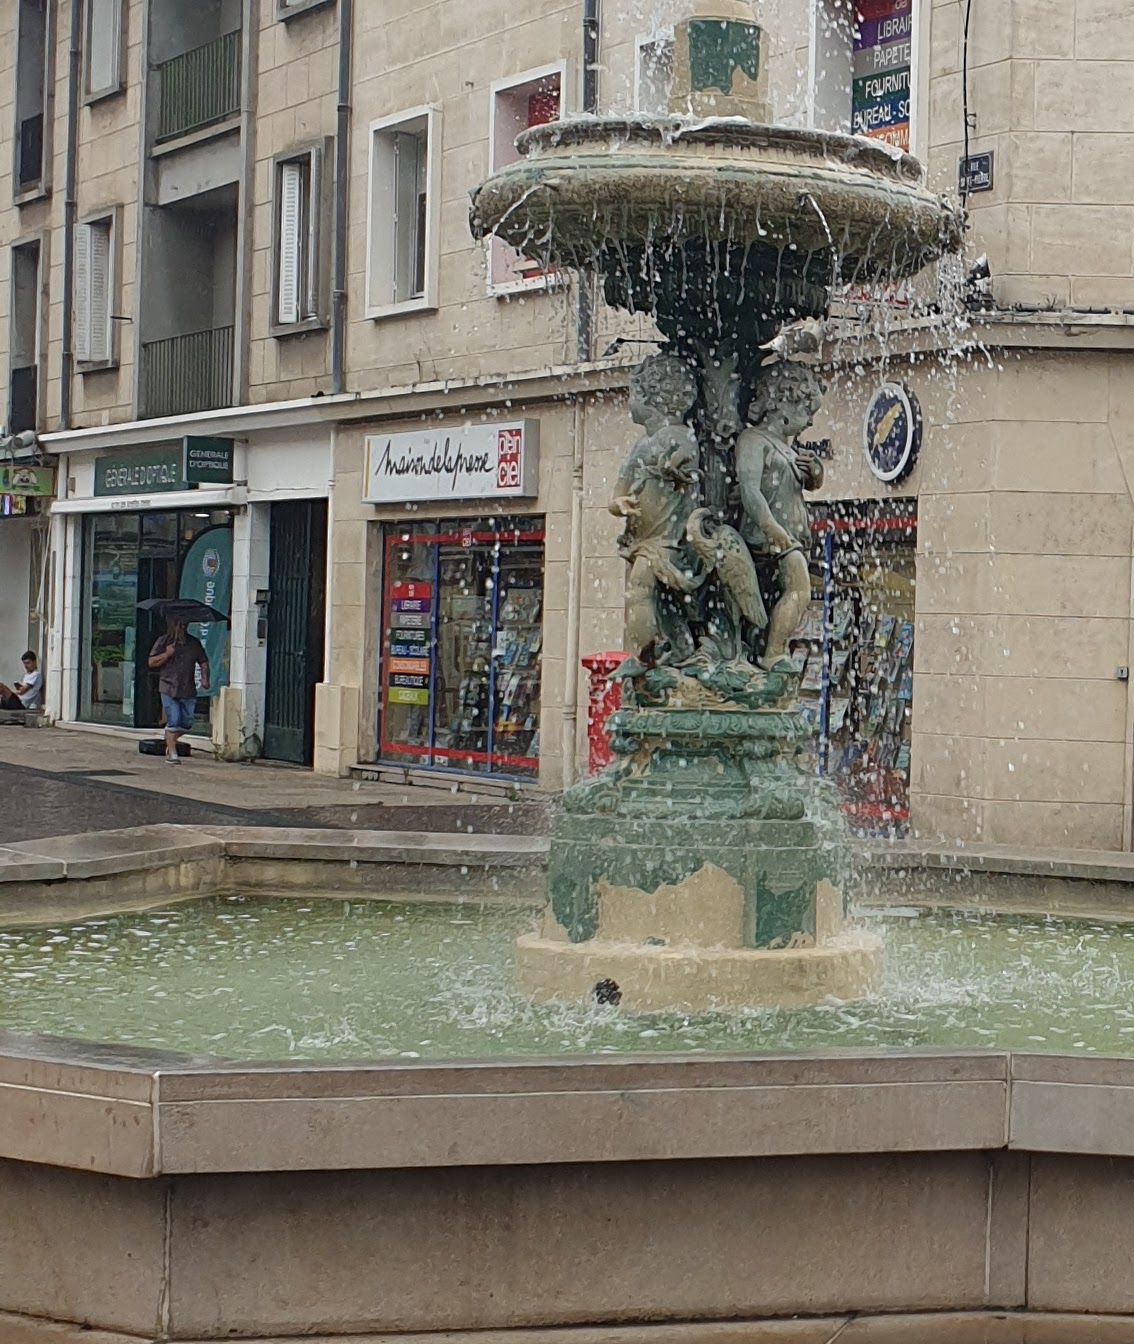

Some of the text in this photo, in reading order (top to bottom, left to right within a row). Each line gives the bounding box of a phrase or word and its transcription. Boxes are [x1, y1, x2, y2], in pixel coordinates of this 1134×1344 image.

[878, 14, 912, 40] LIBRAIR
[874, 43, 911, 69] PAPETE
[498, 430, 521, 457] plein
[498, 453, 521, 486] ciel
